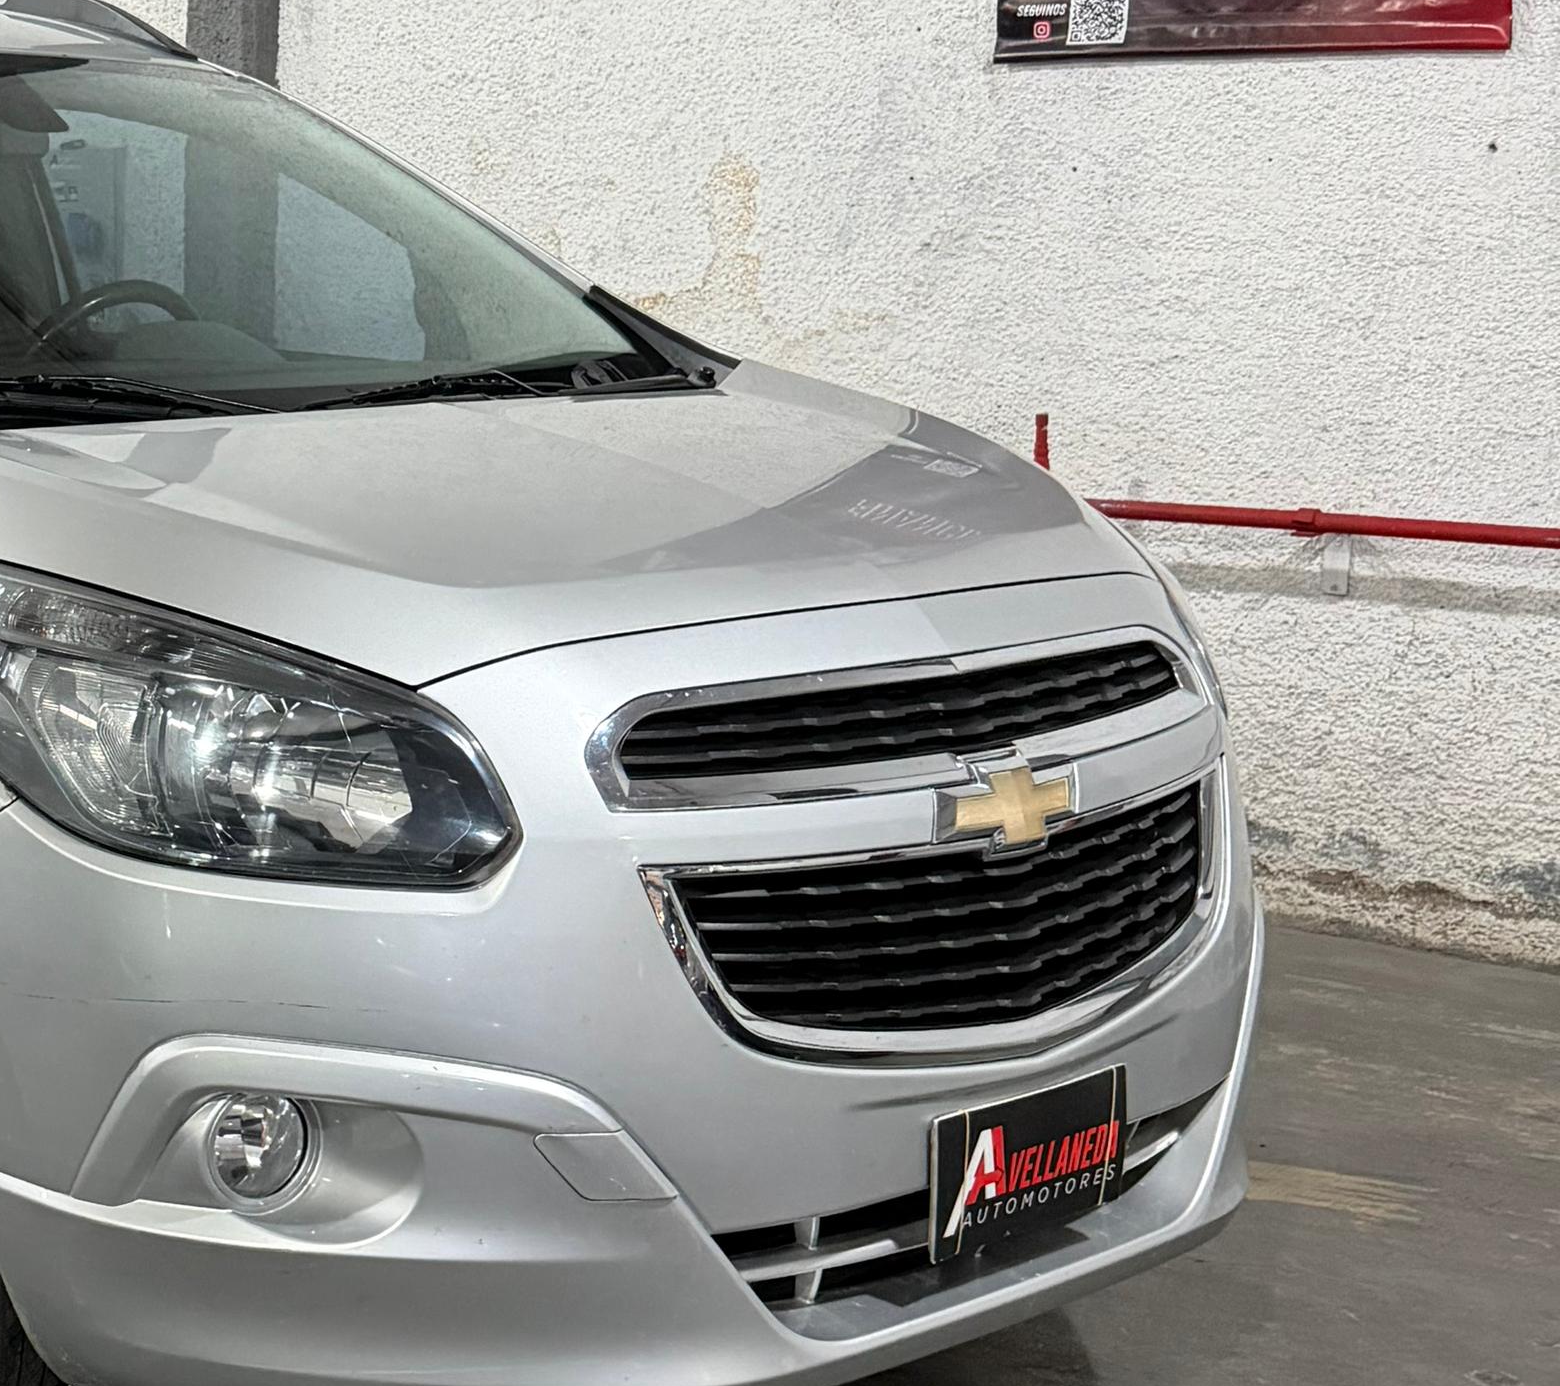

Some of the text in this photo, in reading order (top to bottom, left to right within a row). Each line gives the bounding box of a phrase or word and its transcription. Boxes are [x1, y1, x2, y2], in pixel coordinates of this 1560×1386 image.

[1016, 3, 1068, 17] SEGUINOS
[942, 1120, 1120, 1238] AVELLANEDA
[963, 1163, 1117, 1228] AUTOMOTORES
